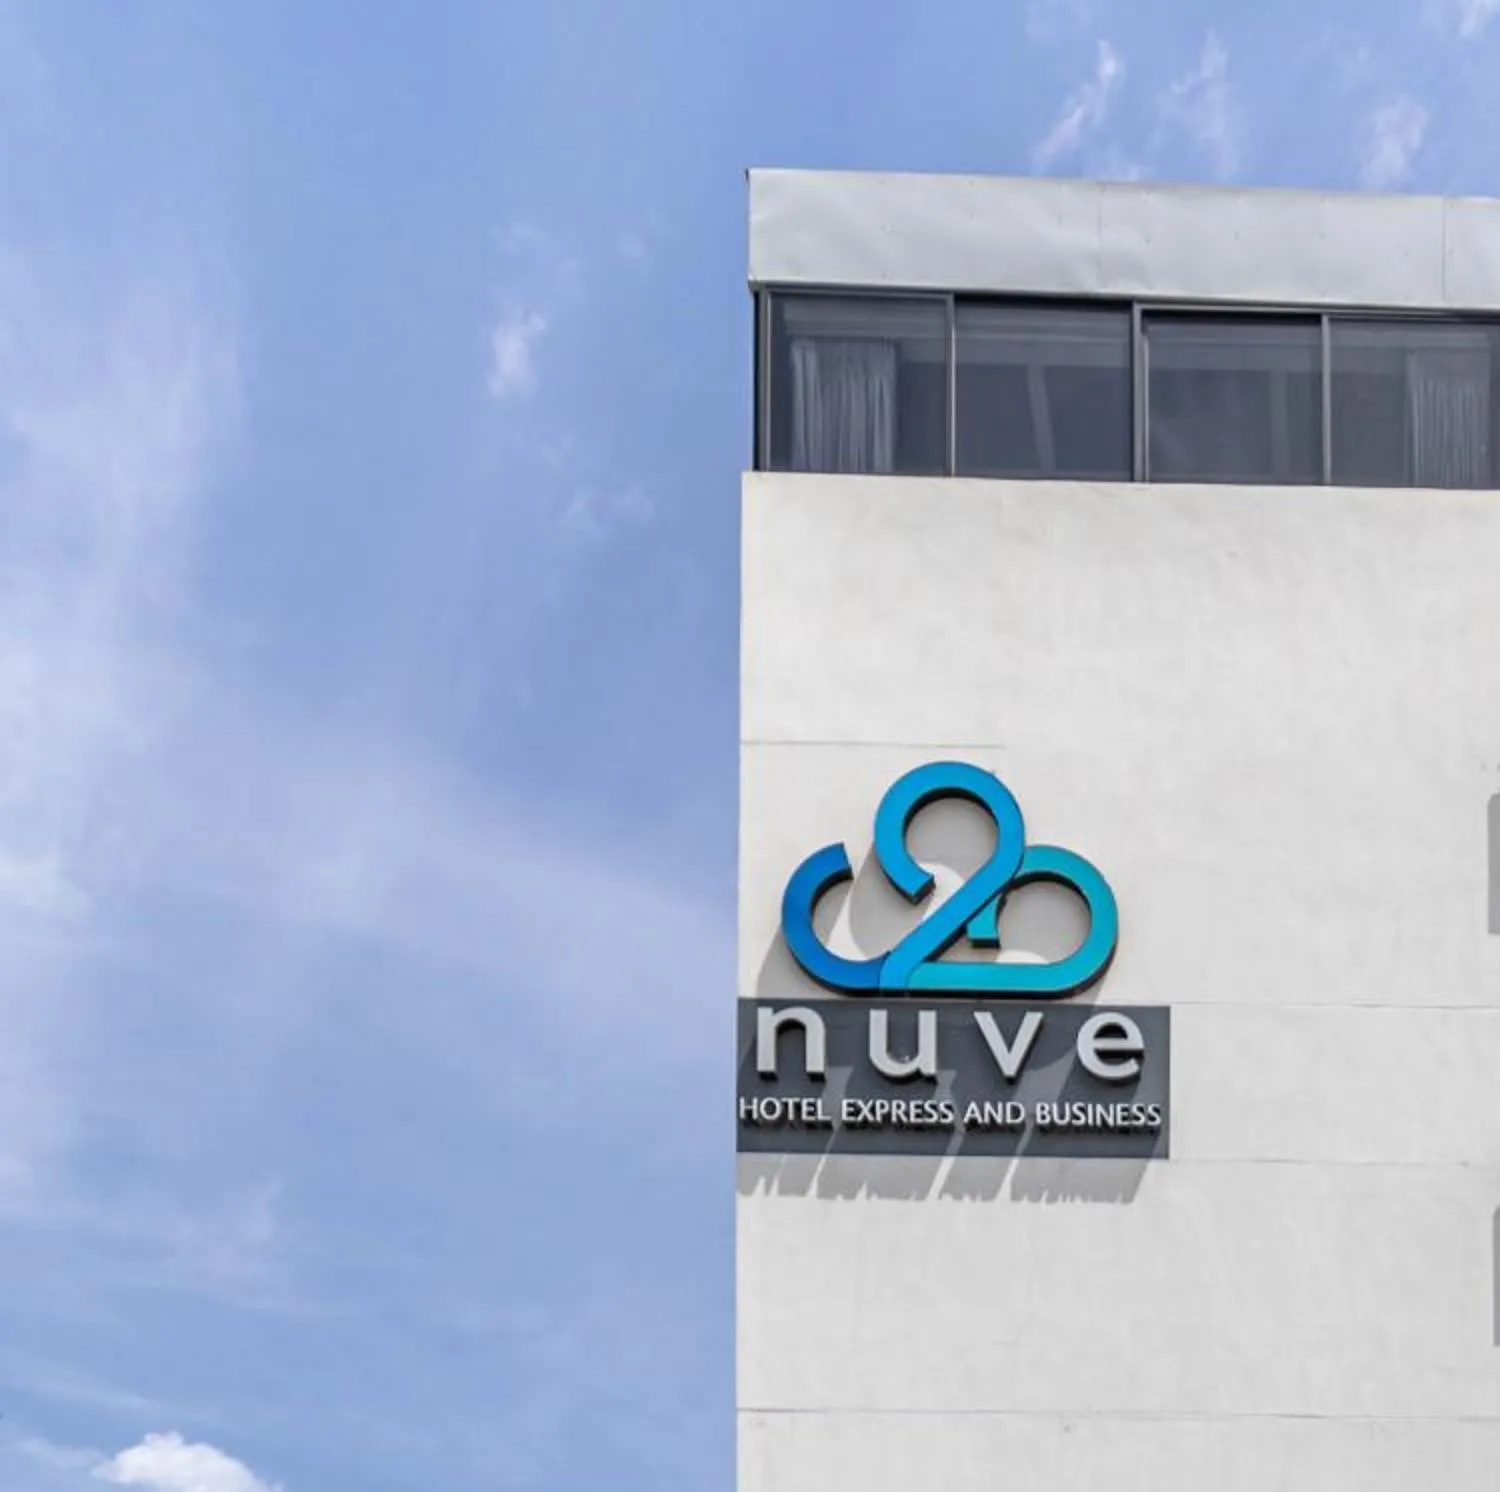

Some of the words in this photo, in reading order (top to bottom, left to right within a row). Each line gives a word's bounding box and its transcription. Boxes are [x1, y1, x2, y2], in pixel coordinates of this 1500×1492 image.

[756, 1005, 1145, 1081] nuve
[740, 1097, 831, 1122] HOTEL
[841, 1099, 954, 1124] EXPRESS
[963, 1101, 1025, 1124] AND
[1035, 1103, 1162, 1127] BUSINESS
